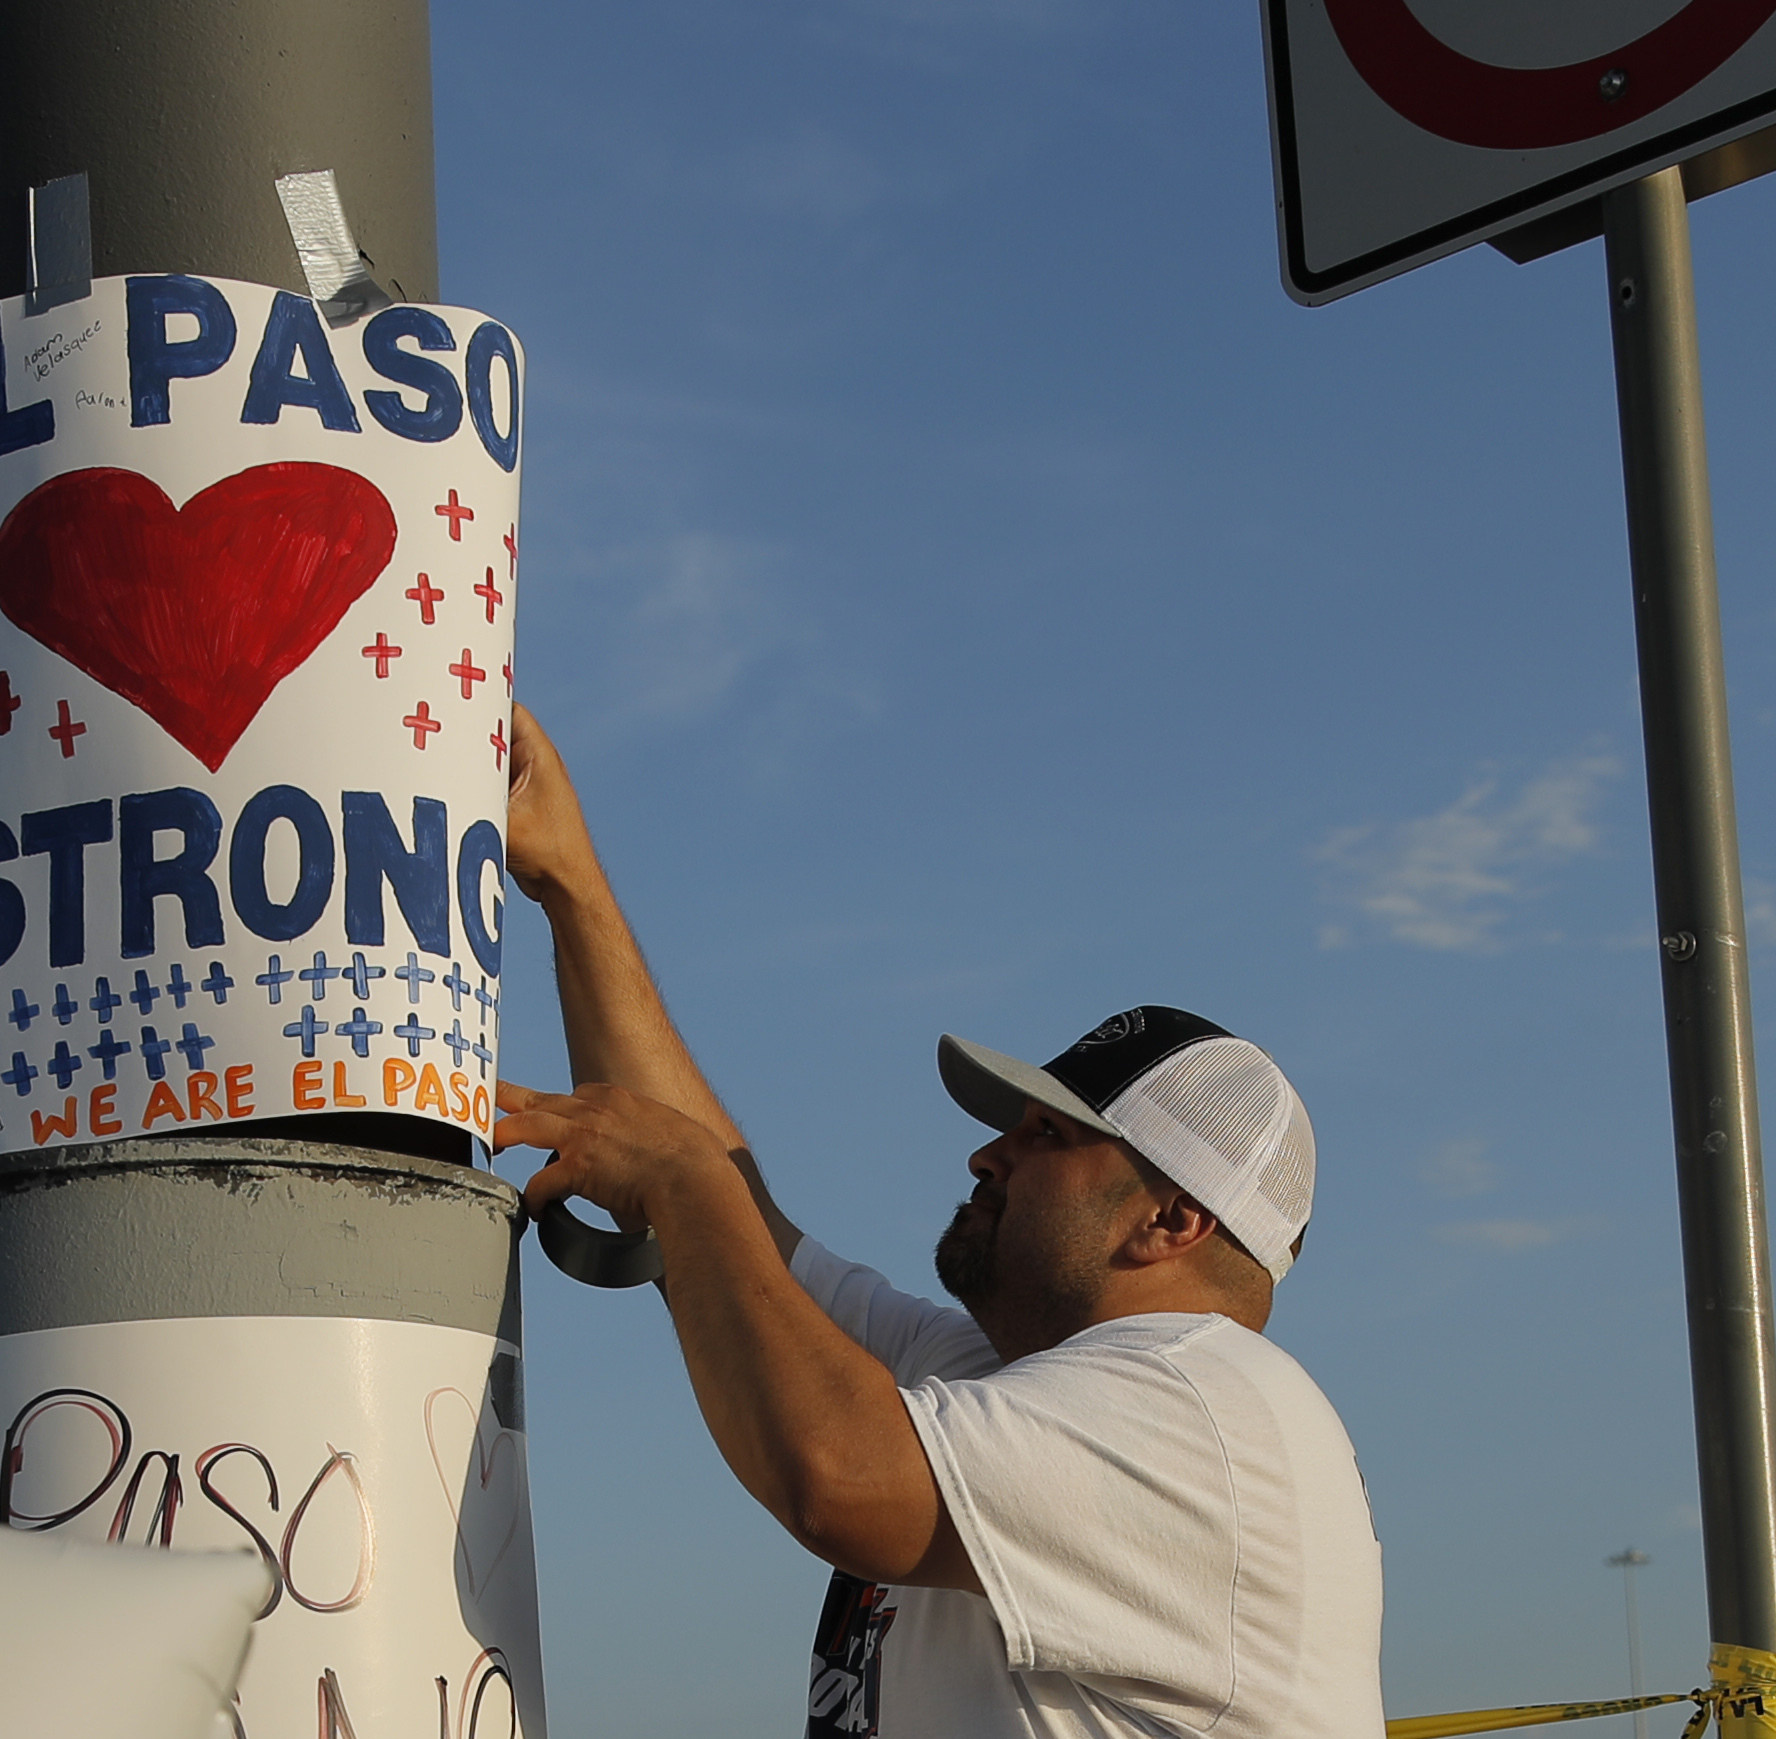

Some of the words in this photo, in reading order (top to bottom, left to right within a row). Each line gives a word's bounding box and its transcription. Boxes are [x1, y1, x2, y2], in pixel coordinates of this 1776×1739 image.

[126, 273, 520, 474] PASO
[30, 1083, 124, 1146] WE
[141, 1063, 255, 1130] ARE
[292, 1060, 366, 1110] EL
[382, 1057, 492, 1135] PASO
